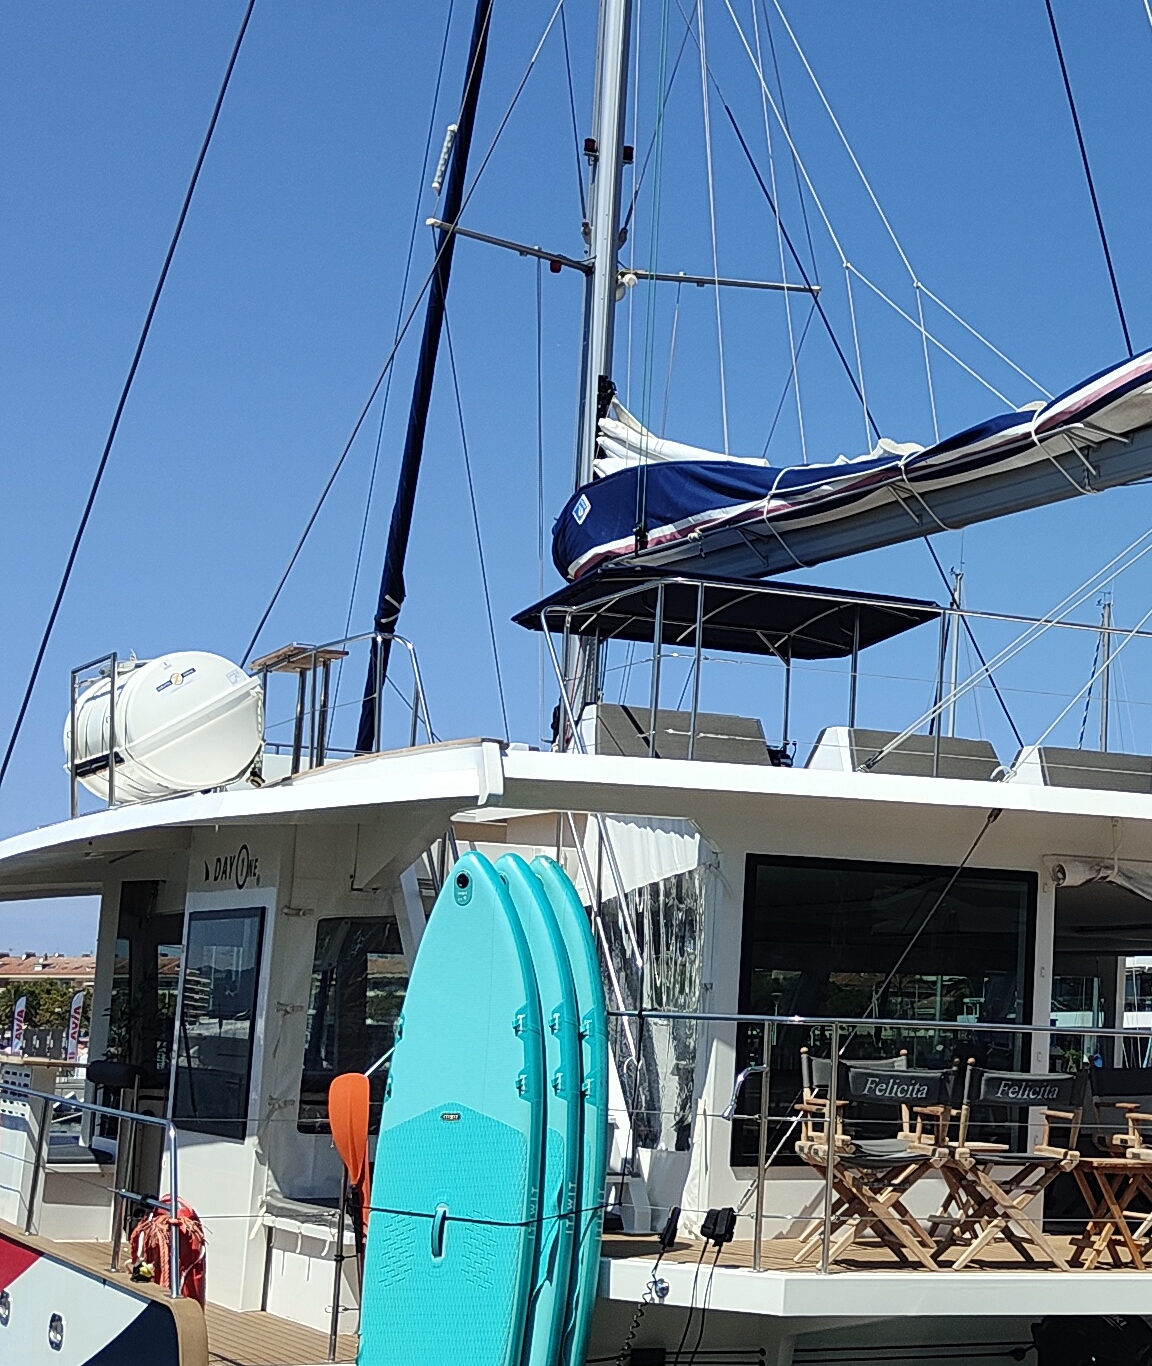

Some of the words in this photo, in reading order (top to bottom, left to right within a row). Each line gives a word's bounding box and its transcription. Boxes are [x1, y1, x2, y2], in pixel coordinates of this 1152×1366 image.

[15, 1009, 25, 1040] AVIA
[71, 1005, 81, 1041] AVIA
[862, 1077, 928, 1098] Felicita
[995, 1080, 1059, 1099] Felicita
